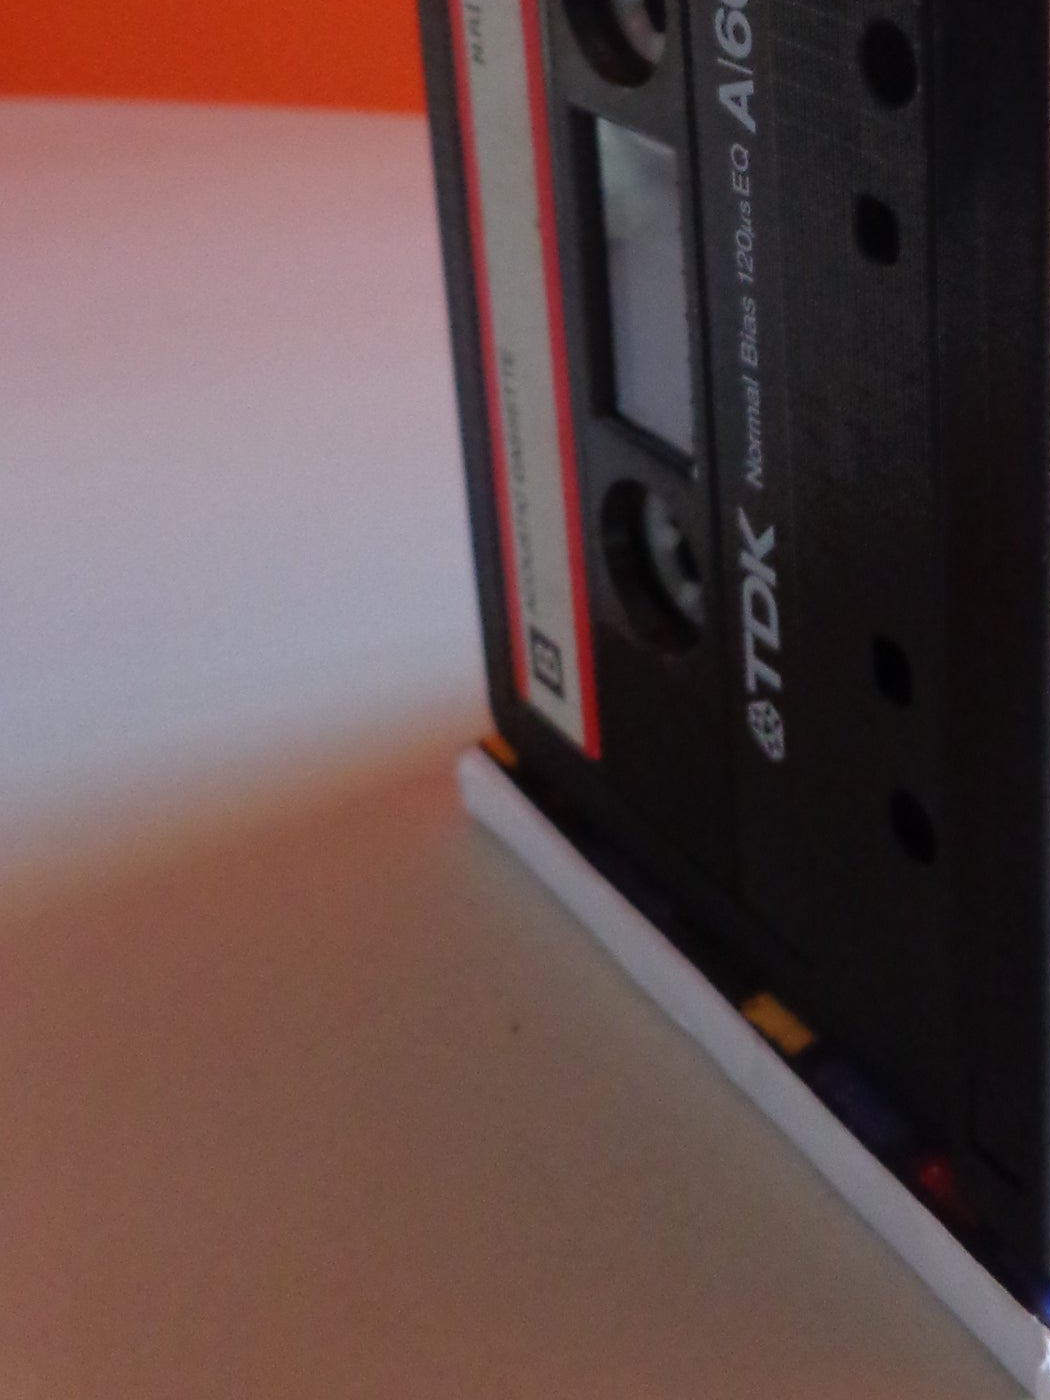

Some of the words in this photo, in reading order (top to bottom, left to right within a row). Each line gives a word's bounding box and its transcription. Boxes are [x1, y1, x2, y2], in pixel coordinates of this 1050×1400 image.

[738, 295, 760, 370] Bias
[741, 374, 765, 493] Normal
[736, 503, 784, 694] TDK
